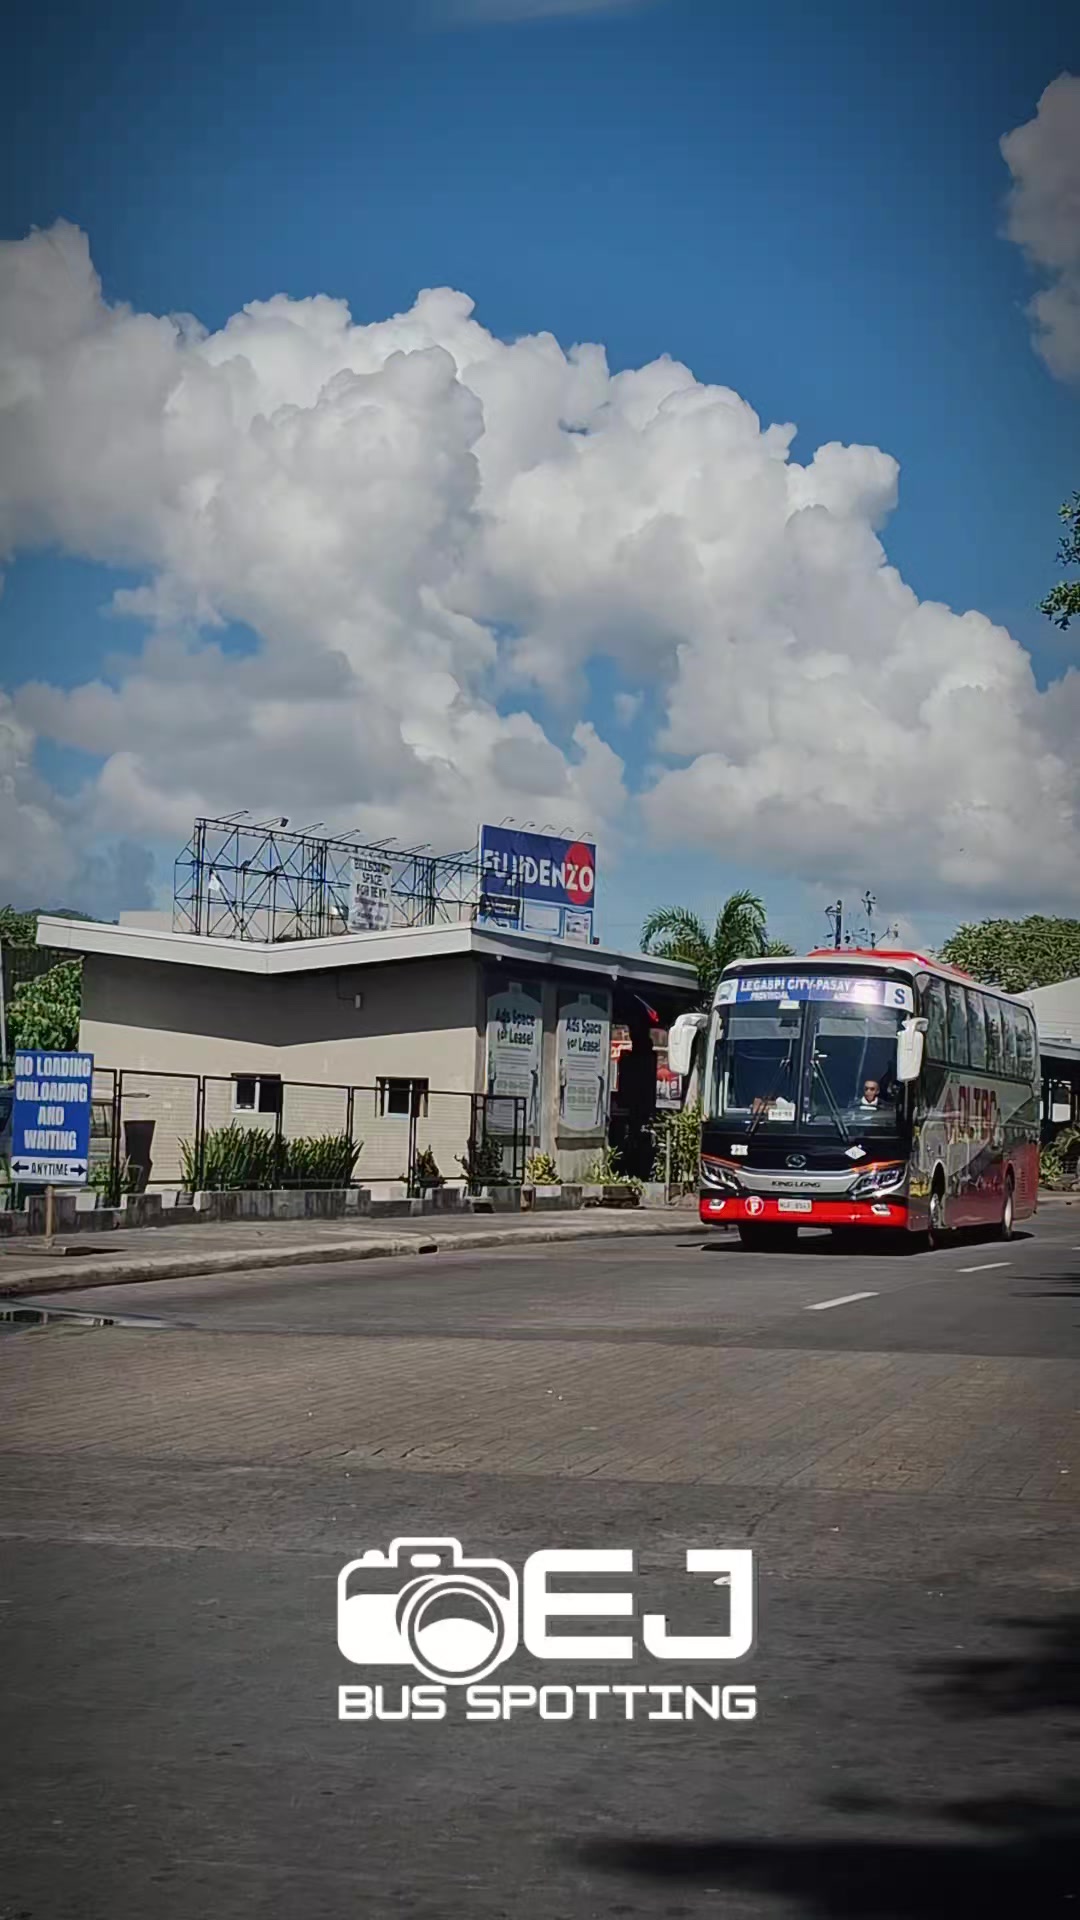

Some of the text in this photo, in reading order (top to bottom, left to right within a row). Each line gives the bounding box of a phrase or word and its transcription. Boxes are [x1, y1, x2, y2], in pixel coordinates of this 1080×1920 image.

[483, 849, 594, 893] FUJIDENZO
[894, 988, 906, 1004] S
[512, 1009, 535, 1029] Space
[581, 1019, 602, 1037] Space
[15, 1056, 91, 1077] NO LOADING
[16, 1081, 88, 1102] UNLOADING
[37, 1106, 65, 1126] AND
[24, 1129, 77, 1151] WAITING
[31, 1162, 69, 1176] ANYTIME
